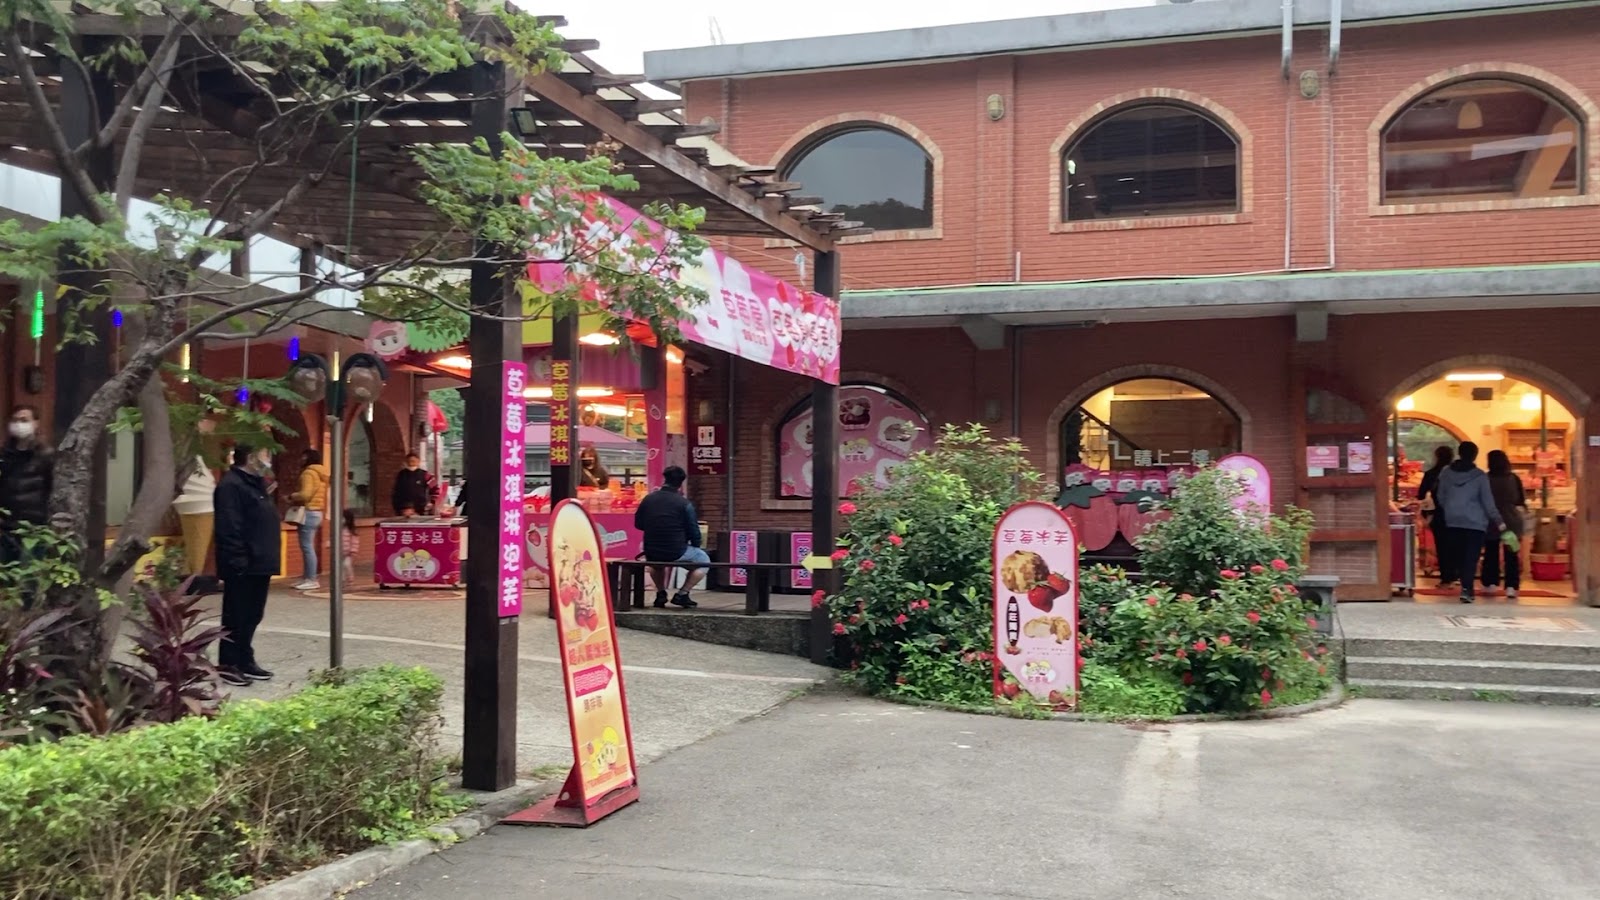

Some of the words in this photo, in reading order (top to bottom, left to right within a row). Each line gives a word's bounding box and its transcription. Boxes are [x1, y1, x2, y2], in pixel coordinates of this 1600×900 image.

[551, 361, 570, 463] 草莓冰淇淋
[386, 531, 444, 545] 草莓冰品
[503, 367, 525, 608] 草莓冰淇淋泡芙
